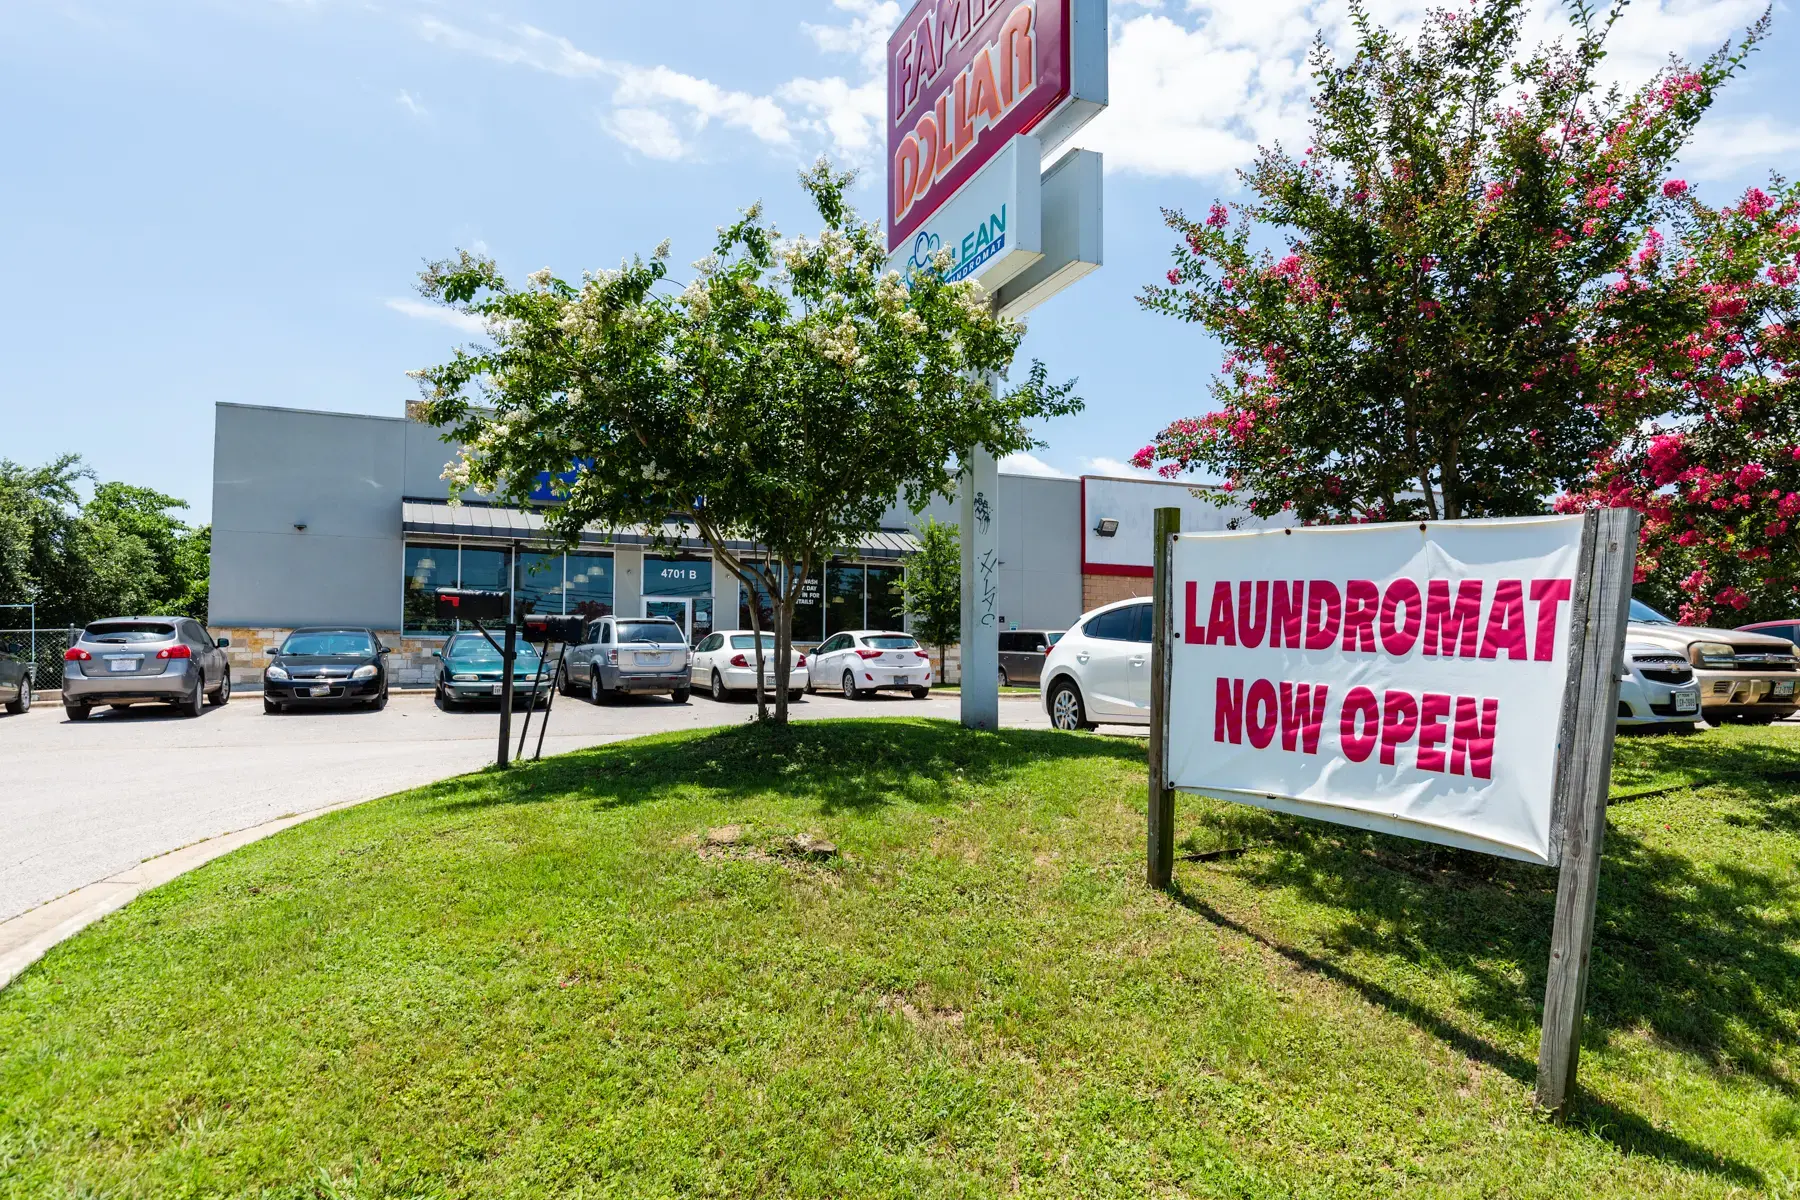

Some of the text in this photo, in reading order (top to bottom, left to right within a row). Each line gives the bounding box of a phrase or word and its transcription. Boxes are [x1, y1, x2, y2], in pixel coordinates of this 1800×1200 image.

[895, 3, 1034, 222] DOLLAR
[661, 568, 697, 579] 4701 B
[1184, 579, 1572, 661] LAUNDROMAT
[1214, 677, 1498, 779] NOW OPEN
